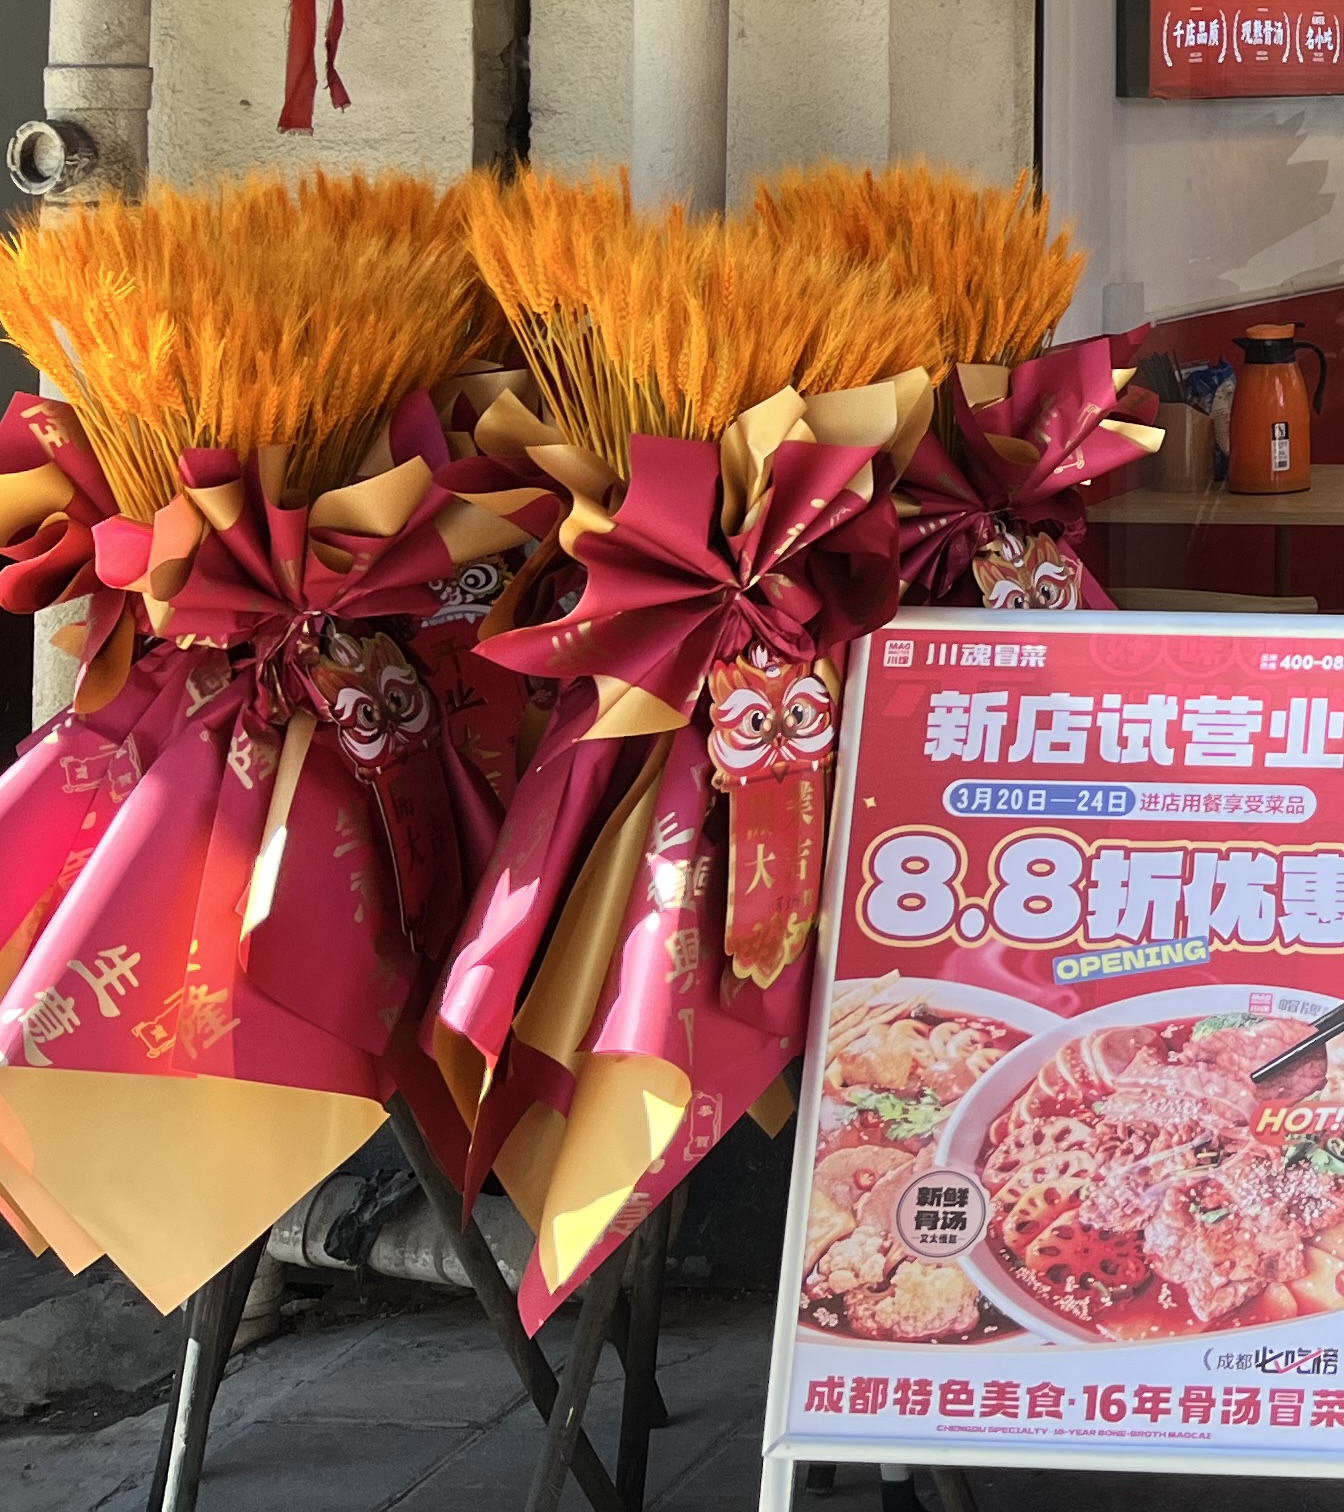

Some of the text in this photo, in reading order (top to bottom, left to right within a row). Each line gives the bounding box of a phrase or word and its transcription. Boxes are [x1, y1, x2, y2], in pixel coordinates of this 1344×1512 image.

[926, 642, 1047, 667] 川魂冒菜
[924, 691, 1344, 769] 新店试营业
[1140, 792, 1305, 817] 进店用餐享受菜品
[1056, 939, 1209, 981] OPENING
[916, 1187, 969, 1207] 新鲜
[914, 1210, 967, 1231] 骨汤
[988, 1426, 1048, 1435] SPECIALTY
